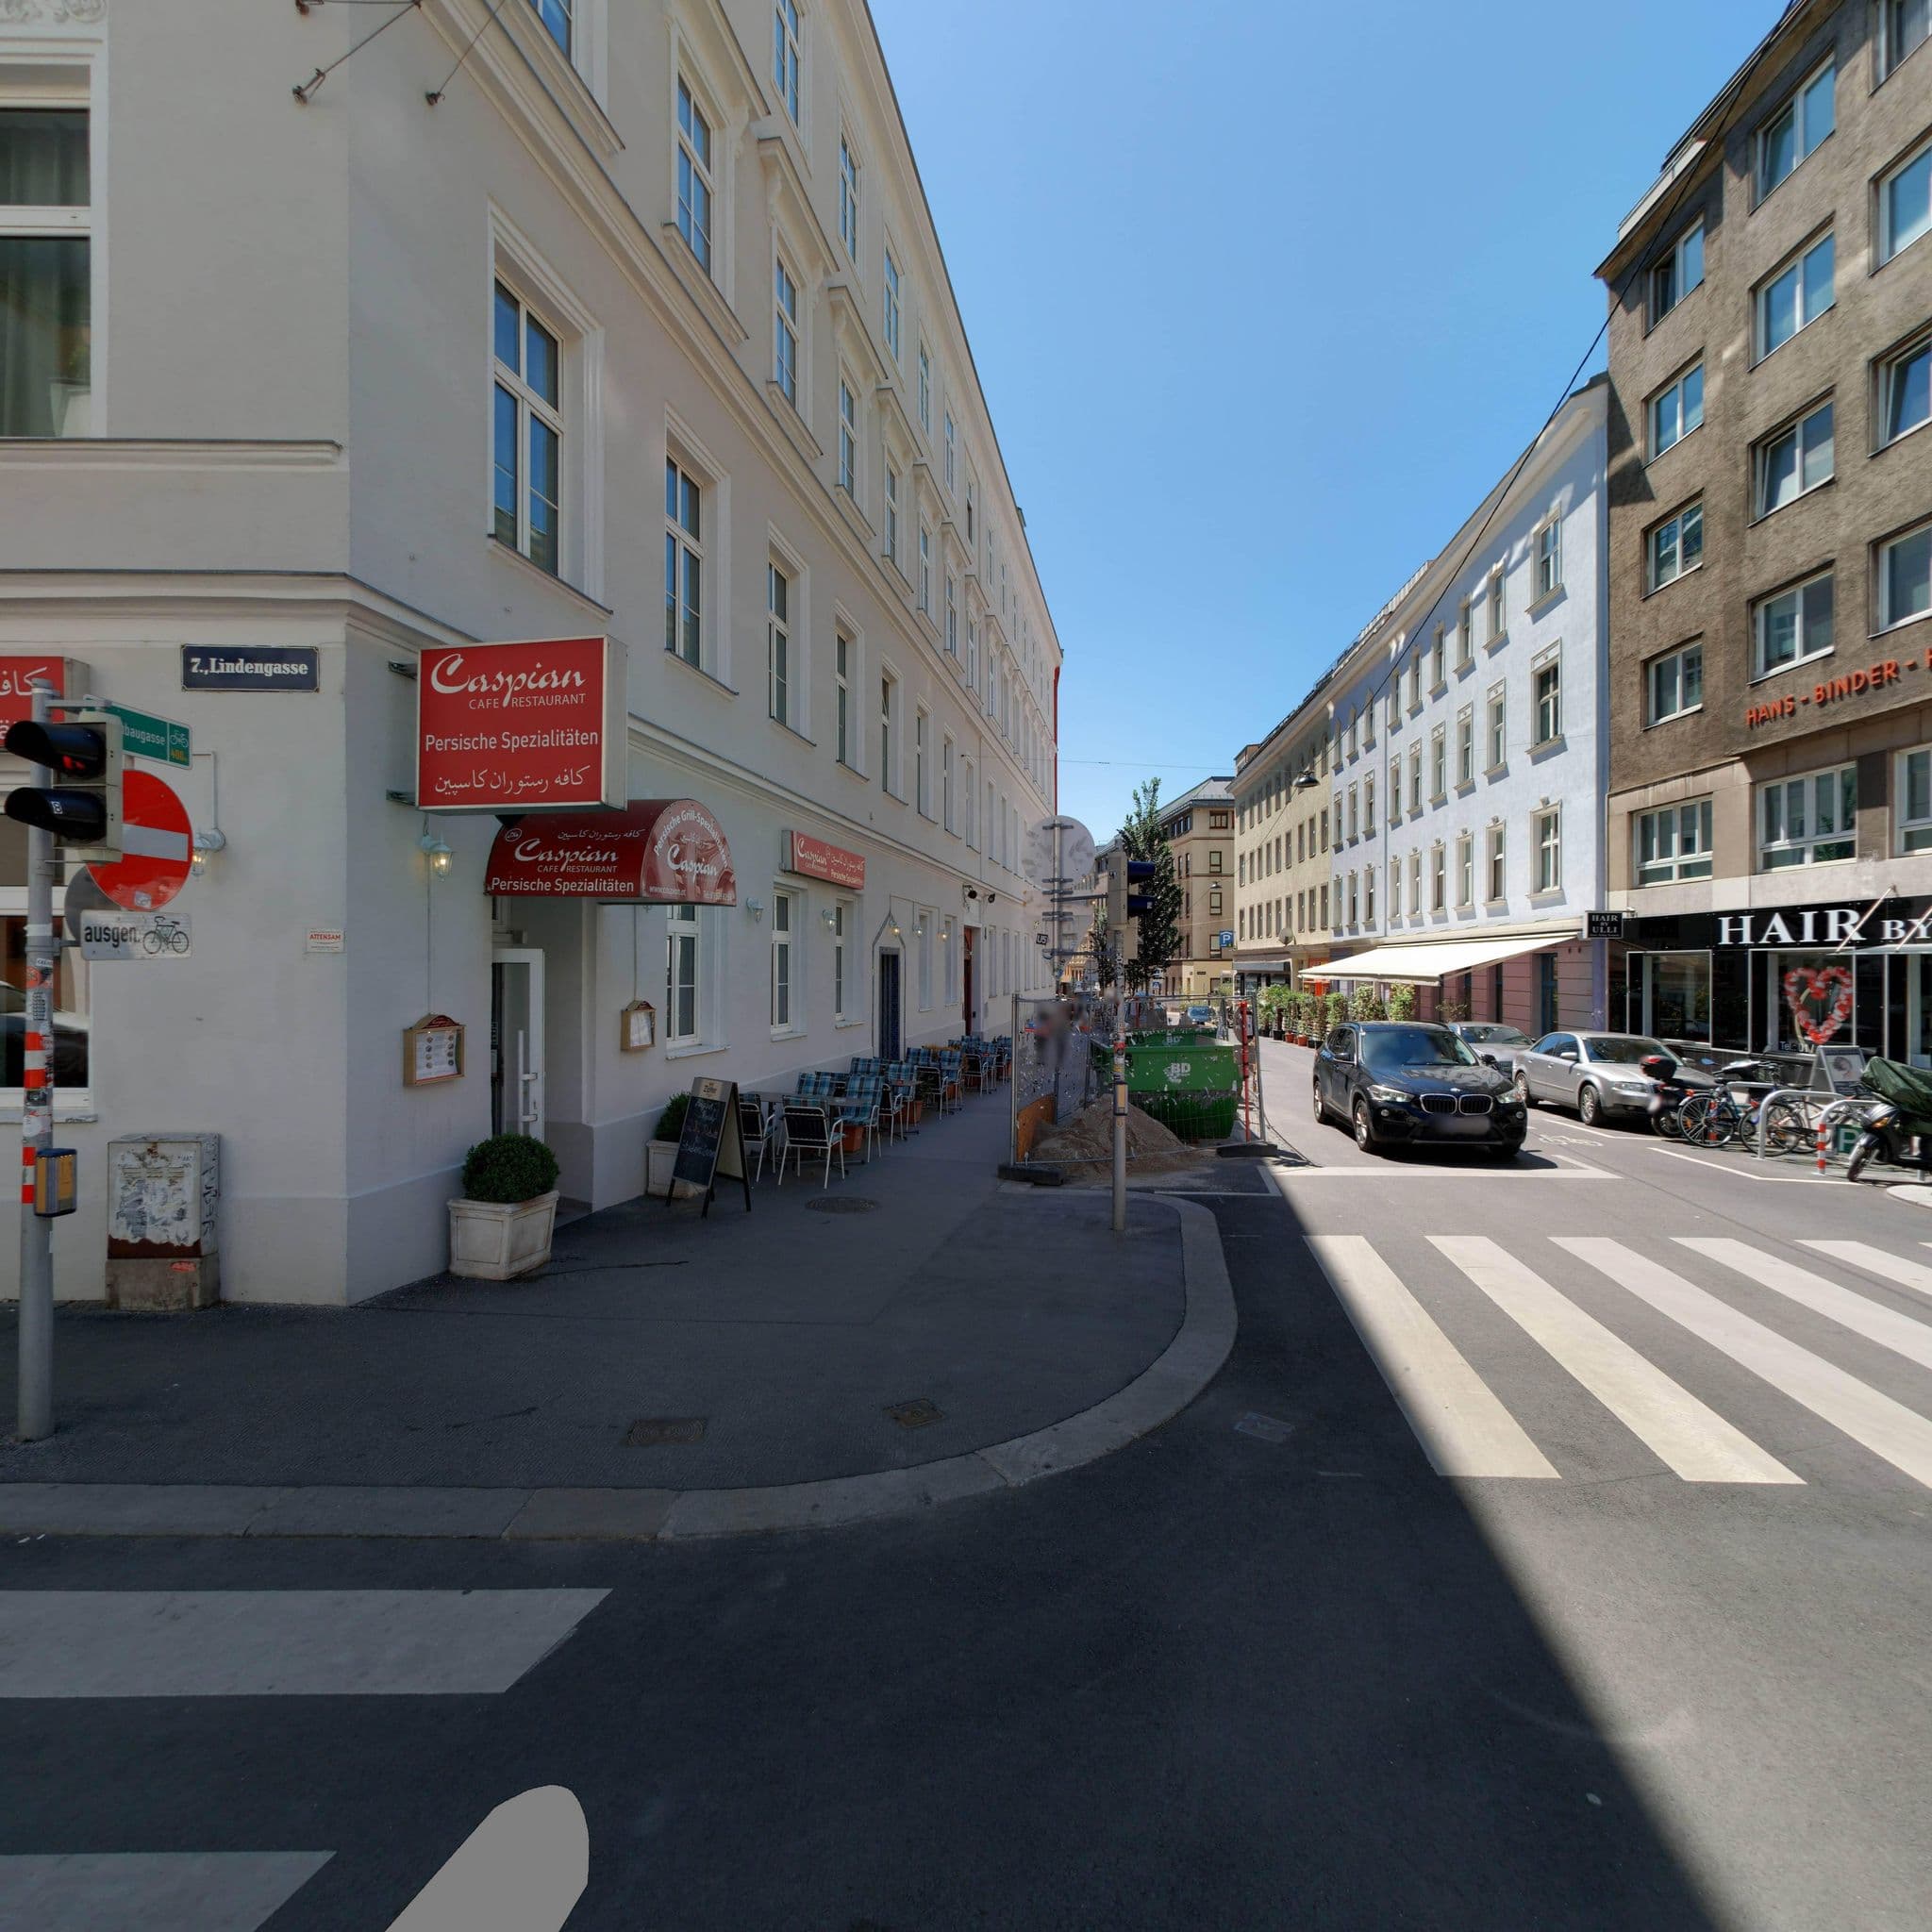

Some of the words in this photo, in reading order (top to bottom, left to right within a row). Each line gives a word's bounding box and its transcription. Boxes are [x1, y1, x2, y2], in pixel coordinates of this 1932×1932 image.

[431, 654, 586, 707] Caspian
[1746, 694, 1794, 725] HANS
[1814, 659, 1899, 704] BINDER
[469, 699, 499, 709] CAFE
[512, 693, 586, 708] RESTAURANT
[123, 724, 166, 745] baugasse
[425, 733, 497, 751] Persische
[501, 728, 598, 753] Spezialitäten
[435, 769, 488, 795] کاسپین
[490, 772, 549, 795] رستوران
[554, 765, 591, 785] کافه
[514, 839, 619, 872] Caspian
[667, 843, 717, 883] Caspian
[491, 877, 551, 891] Persische
[555, 877, 634, 893] Spezialitäten
[84, 925, 141, 948] ausgen.
[1718, 908, 1867, 944] HAIR
[1880, 918, 1932, 940] BY
[1223, 934, 1231, 943] P
[1171, 1062, 1191, 1074] BD
